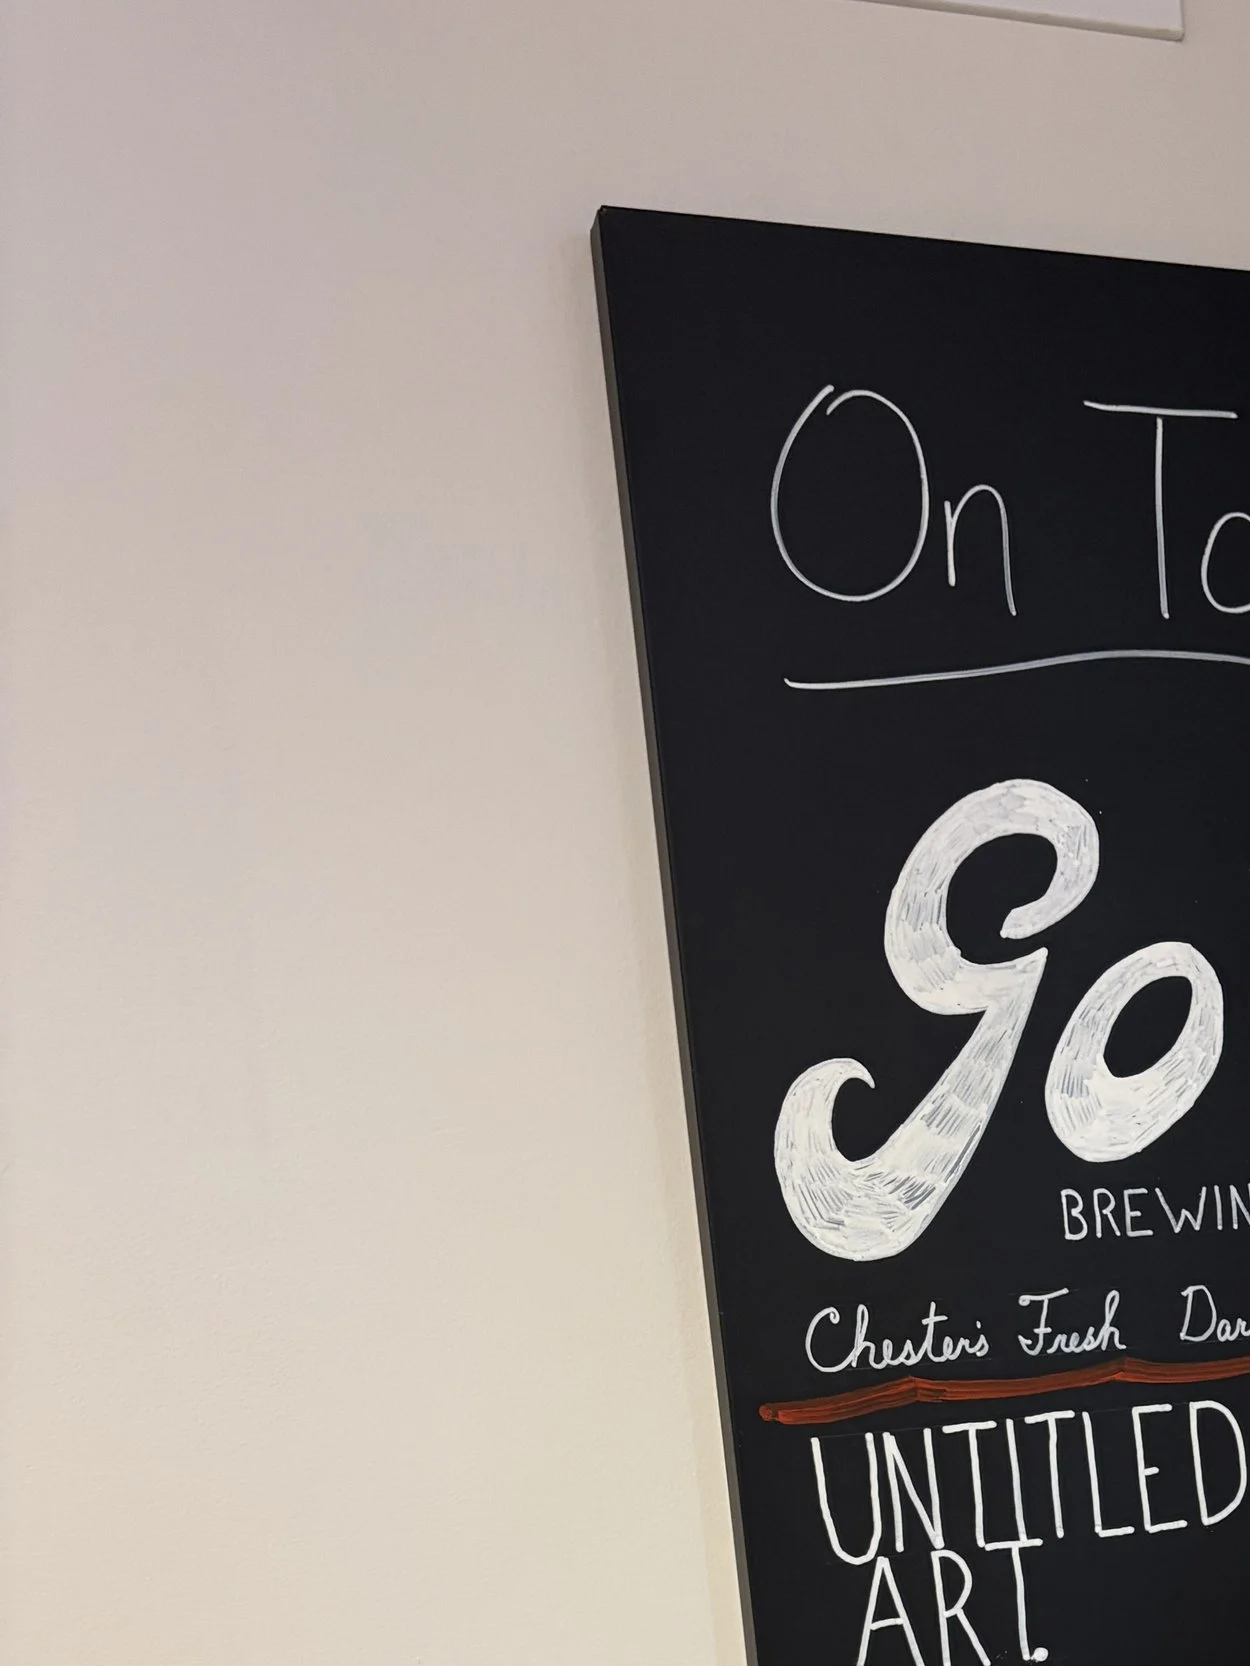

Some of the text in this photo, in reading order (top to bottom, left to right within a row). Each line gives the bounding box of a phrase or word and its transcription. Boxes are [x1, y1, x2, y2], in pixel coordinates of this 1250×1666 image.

[771, 385, 1016, 616] On
[804, 1301, 990, 1373] Chester's
[1017, 1287, 1127, 1356] Fresh
[810, 1400, 1248, 1564] UNTITLED
